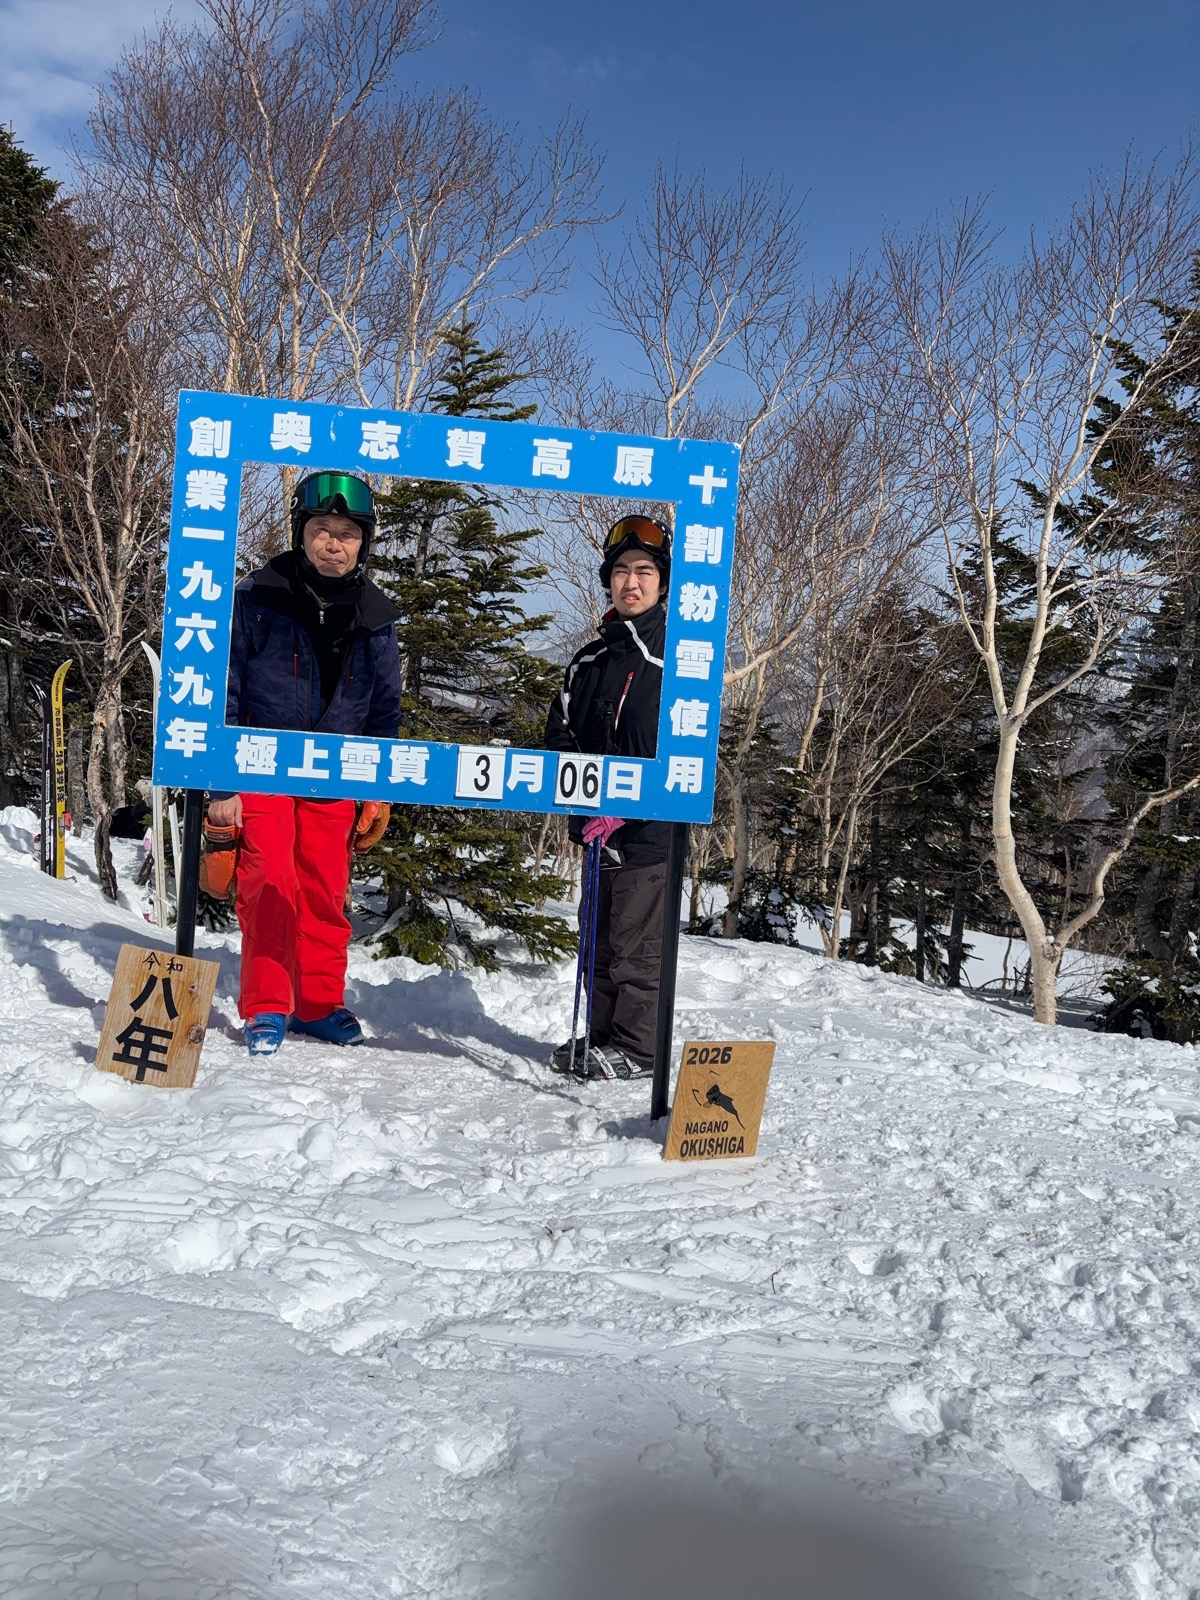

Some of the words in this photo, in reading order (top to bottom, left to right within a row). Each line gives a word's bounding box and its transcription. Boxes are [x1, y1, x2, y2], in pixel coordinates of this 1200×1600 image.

[270, 411, 655, 487] 奥志賀高原
[164, 416, 232, 758] 創業一九六九年
[664, 465, 728, 794] 十割粉雪使用
[234, 735, 430, 785] 極上雪質
[142, 952, 184, 974] 令和
[686, 1046, 733, 1065] 2026
[684, 1120, 729, 1135] NAGANO
[680, 1136, 745, 1157] OKUSHIGA
